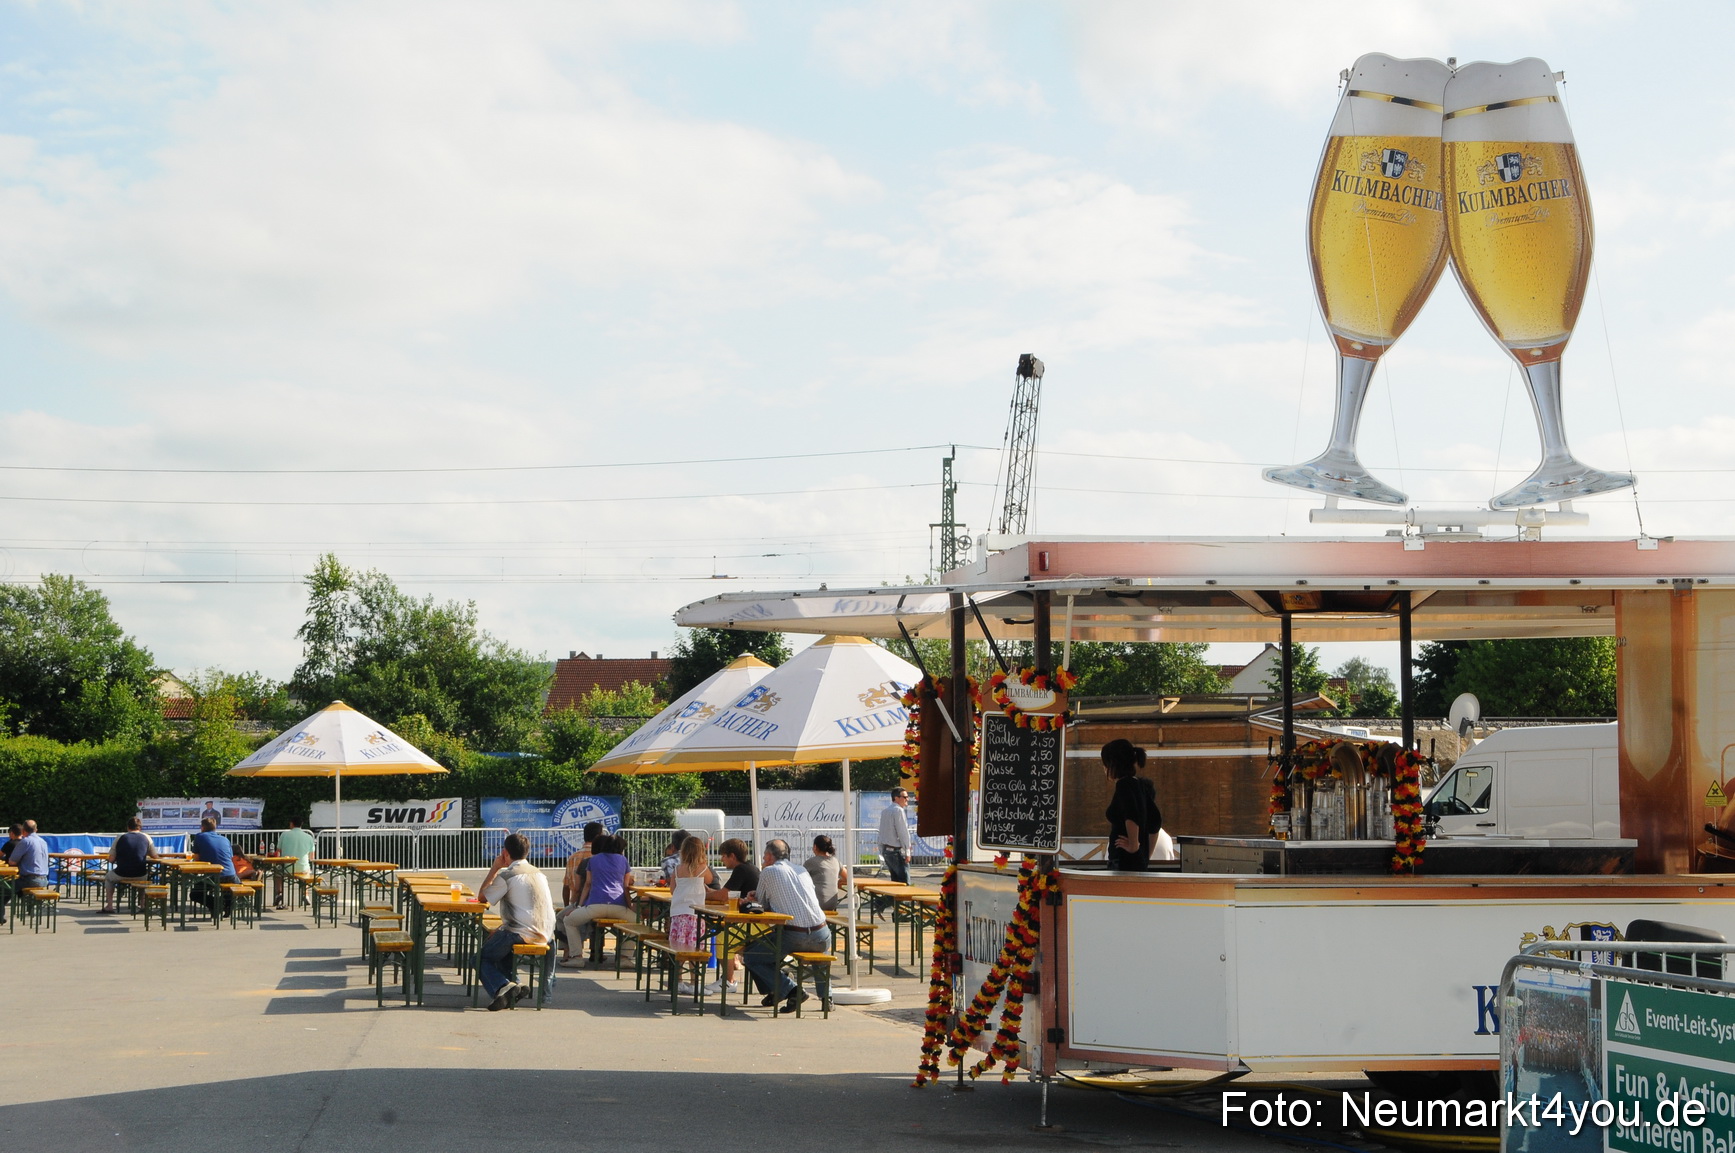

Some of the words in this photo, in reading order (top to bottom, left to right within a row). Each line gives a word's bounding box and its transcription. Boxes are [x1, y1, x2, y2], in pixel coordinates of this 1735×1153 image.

[1331, 169, 1444, 212] KULMBACHER
[1457, 178, 1572, 214] KULMBACHER
[1005, 686, 1049, 699] ULMBACHER
[987, 719, 1007, 733] Bier
[988, 732, 1020, 747] Radler
[1031, 735, 1056, 748] 2,50
[989, 748, 1020, 762] Weizen
[1030, 750, 1053, 762] 2,50
[986, 762, 1015, 776] Russe
[1031, 764, 1055, 777] 2,50
[986, 778, 1008, 791] Coca
[1008, 779, 1027, 791] Cola
[1030, 779, 1055, 792] 2,50
[1032, 794, 1056, 808] 2,50
[366, 807, 426, 824] swn
[553, 795, 610, 824] Blitzschutztechnik
[774, 798, 804, 822] Blu
[807, 799, 853, 823] Bow
[984, 821, 1015, 834] Wasser
[1036, 823, 1058, 836] 2,50
[1615, 1063, 1649, 1100] Fun
[1655, 1071, 1670, 1103] &
